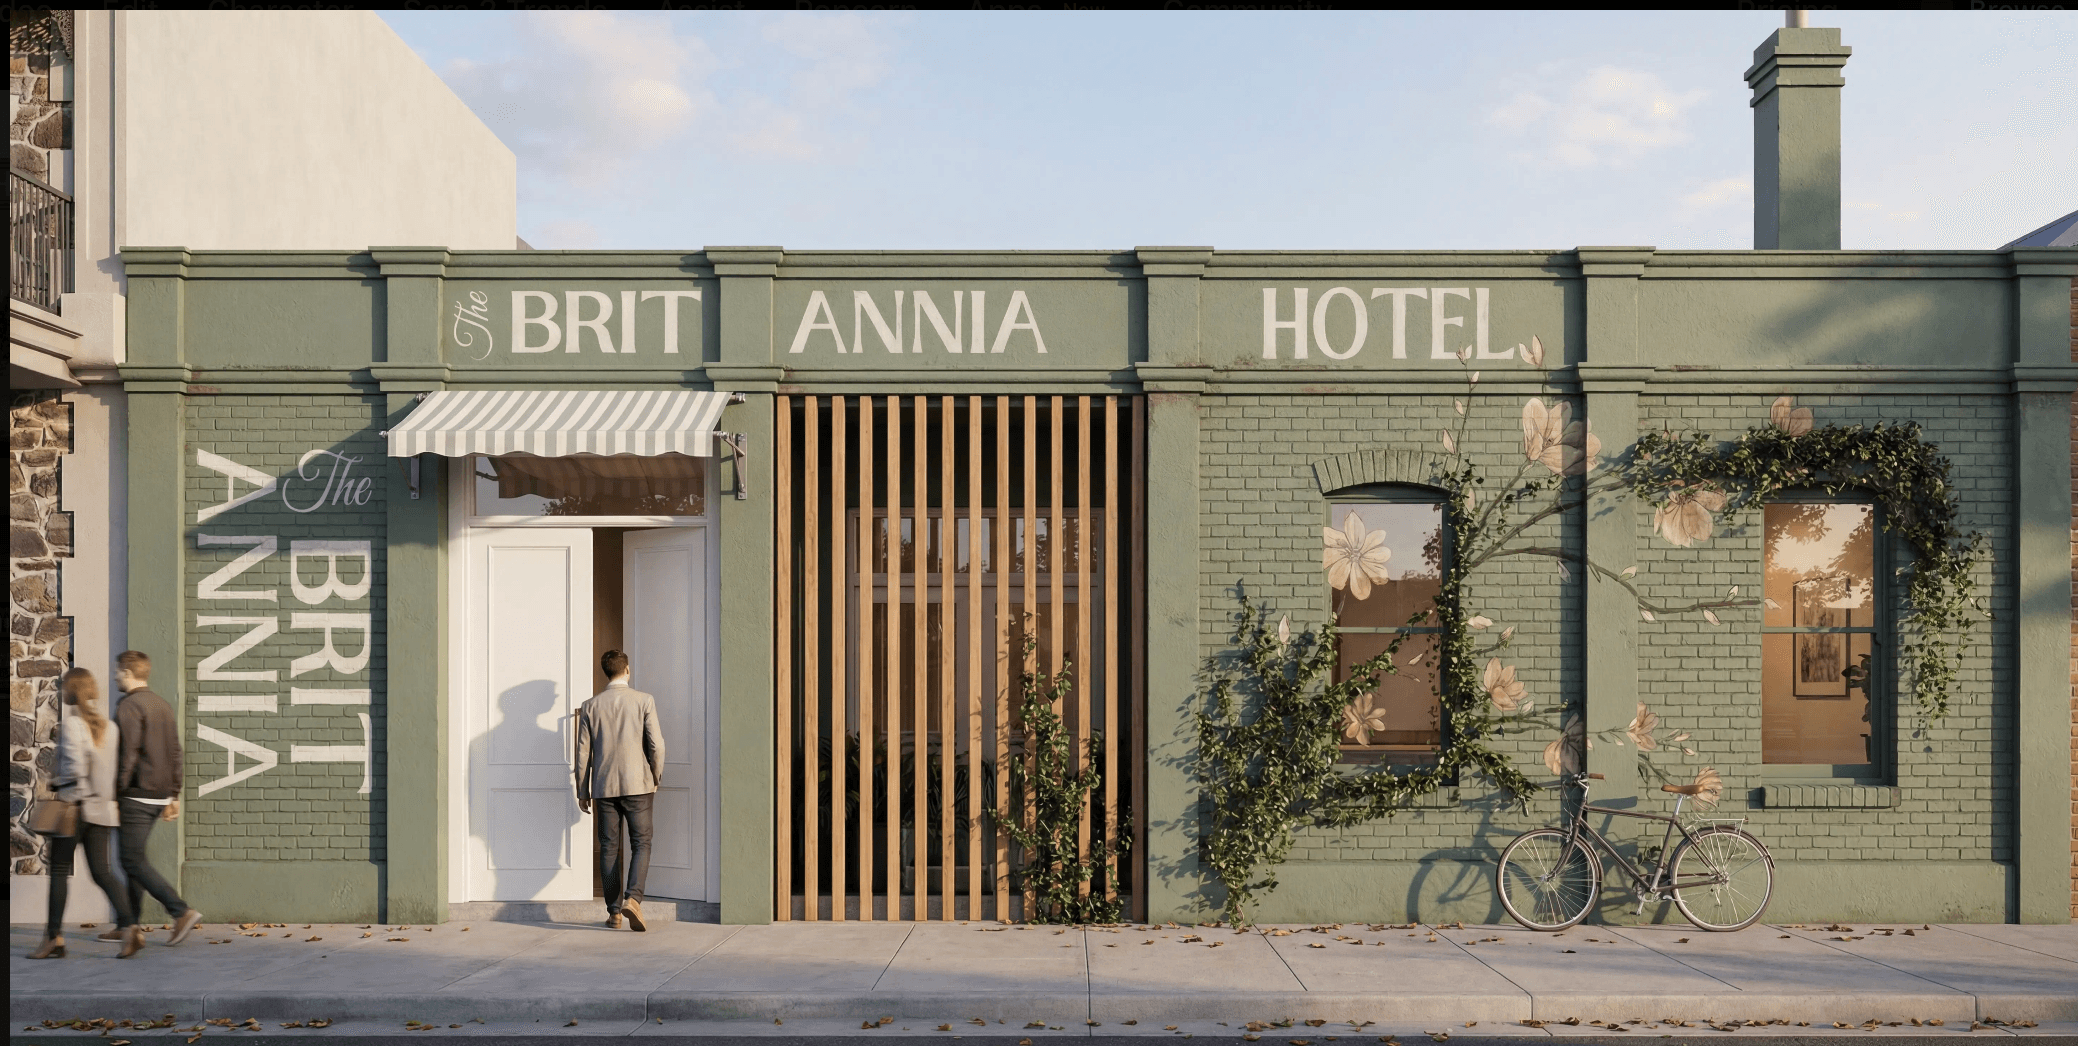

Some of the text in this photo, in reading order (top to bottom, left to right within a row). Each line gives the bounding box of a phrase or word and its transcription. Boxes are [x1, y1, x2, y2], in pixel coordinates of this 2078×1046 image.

[453, 286, 1515, 361] The BRIT ANNIA HOTEL
[282, 449, 373, 513] The
[196, 447, 279, 798] ANNIA
[289, 539, 373, 794] BRIT
